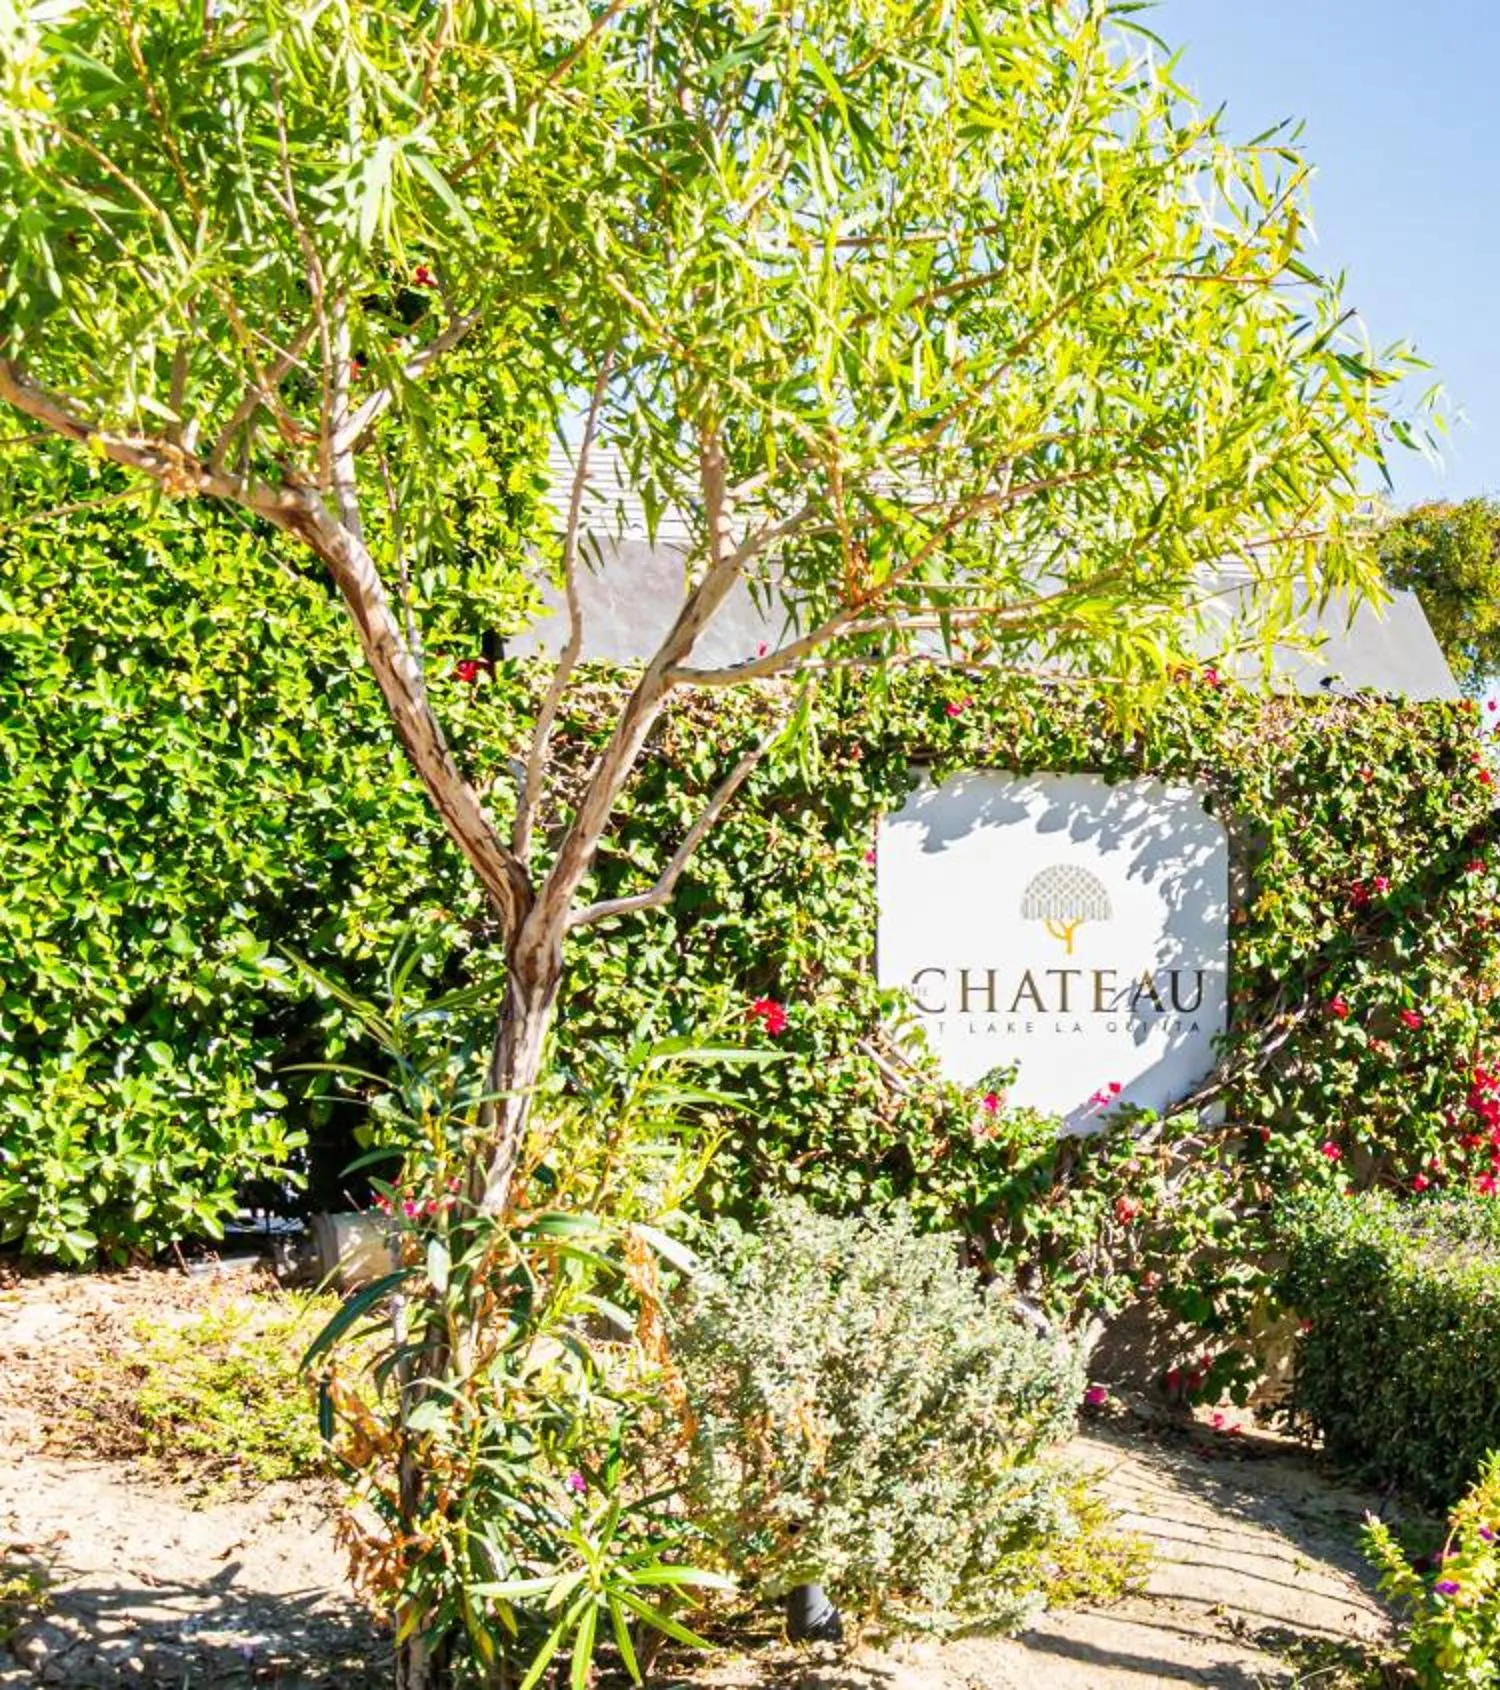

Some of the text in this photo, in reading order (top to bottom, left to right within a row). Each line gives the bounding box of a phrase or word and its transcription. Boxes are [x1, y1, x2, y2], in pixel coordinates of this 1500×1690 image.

[911, 967, 1207, 1014] CHATEAU
[968, 1021, 1034, 1034] LAKE
[1054, 1021, 1082, 1033] LA
